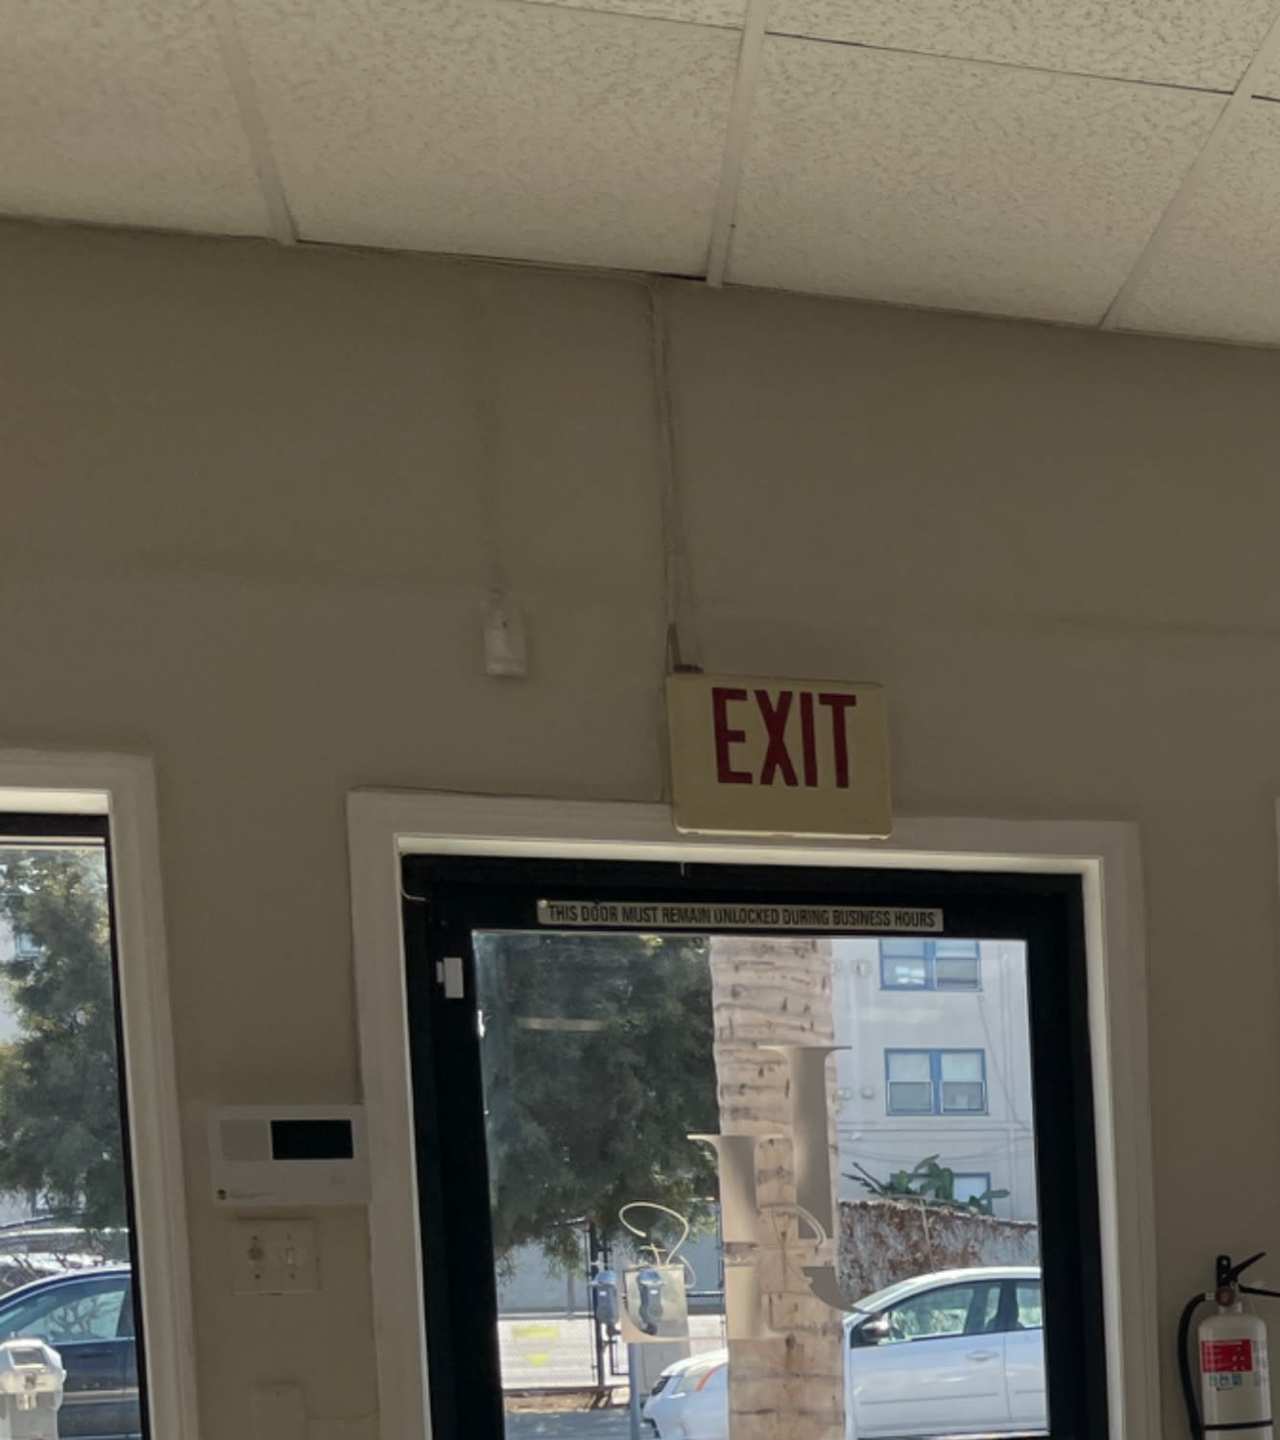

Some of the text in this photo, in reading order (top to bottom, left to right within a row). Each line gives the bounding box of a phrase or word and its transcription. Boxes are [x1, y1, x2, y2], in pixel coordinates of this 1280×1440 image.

[712, 687, 857, 788] EXIT
[550, 904, 935, 928] THIS DOOR MUST REMAIN UNLOCKED DURING BUSINESS HOURS
